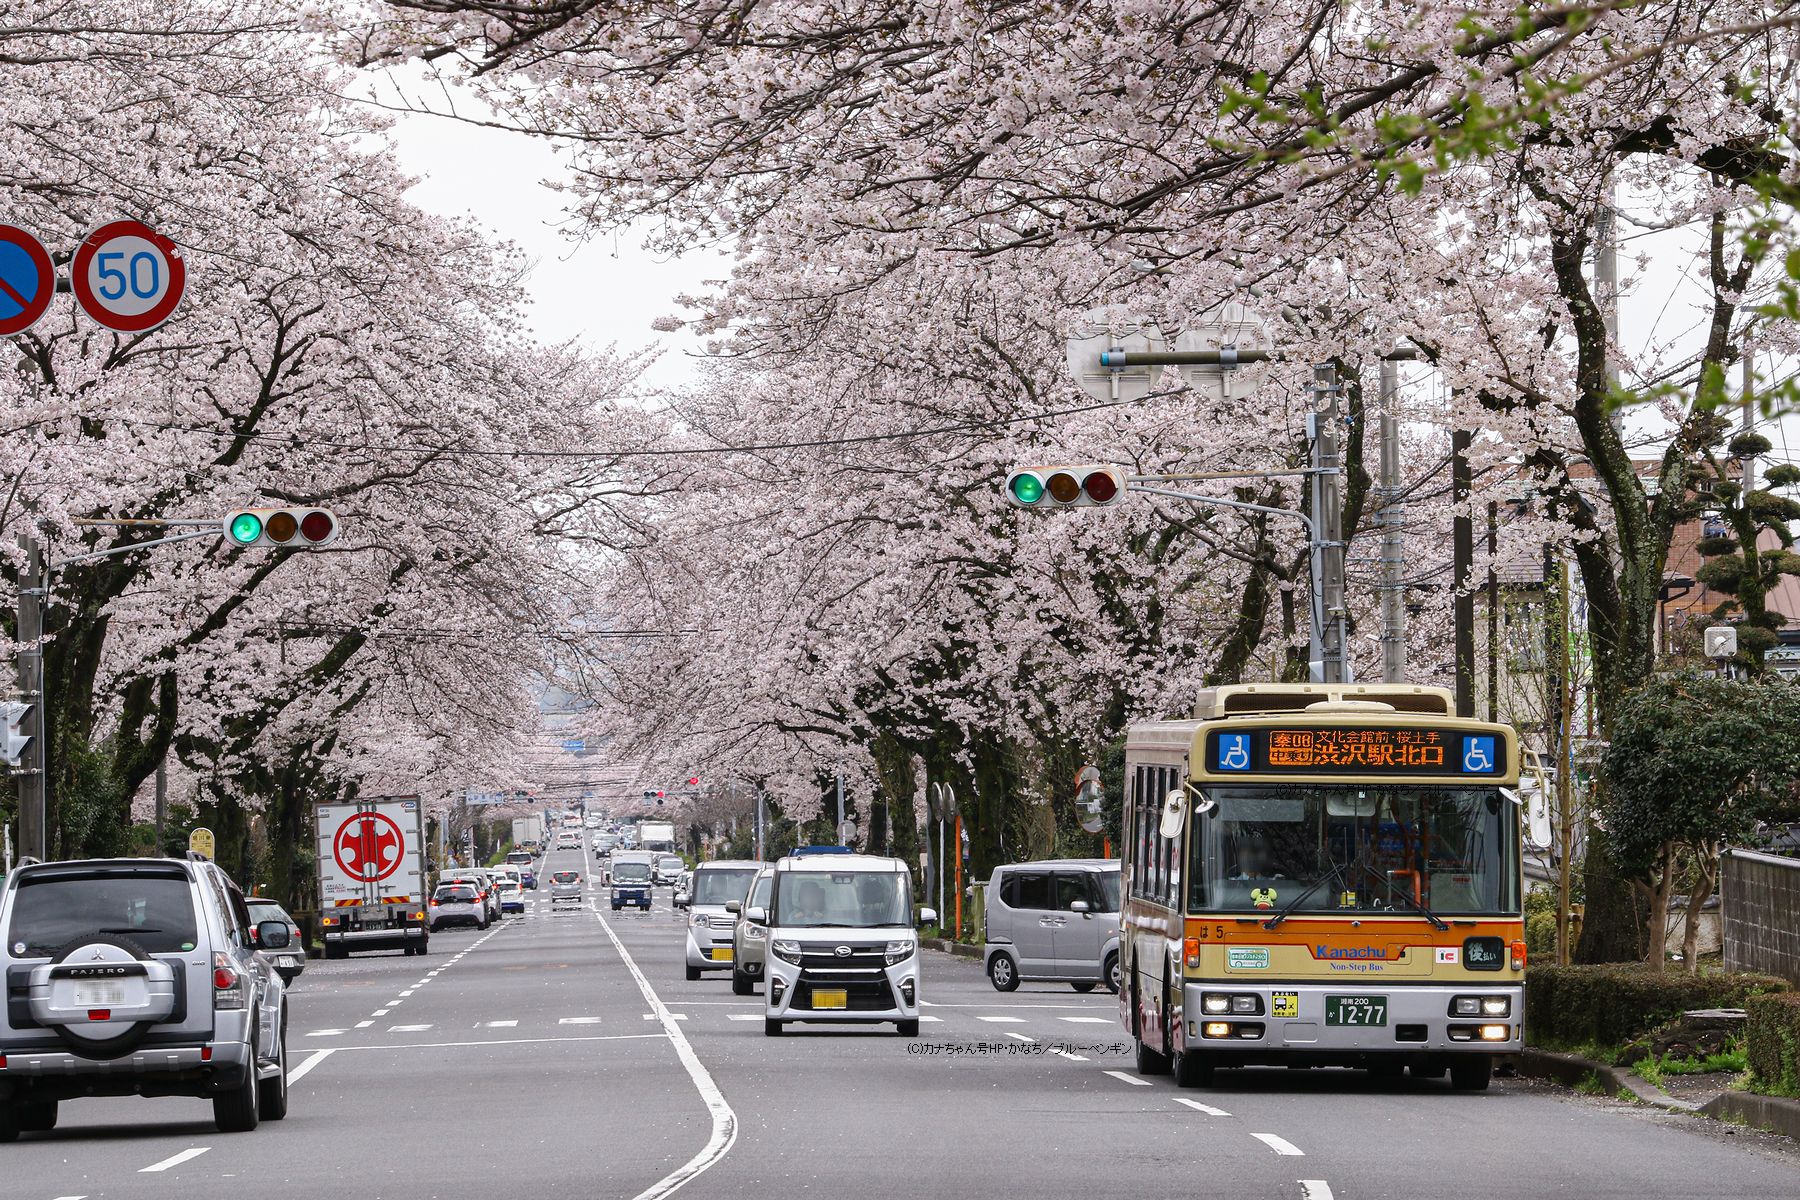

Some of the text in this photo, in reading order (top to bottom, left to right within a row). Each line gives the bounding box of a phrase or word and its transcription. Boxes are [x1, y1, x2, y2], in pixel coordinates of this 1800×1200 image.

[98, 251, 159, 300] 50
[1316, 731, 1440, 744] 文化会館前・桜土手
[1314, 743, 1443, 766] 渋沢駅北口
[1200, 925, 1224, 939] は 5
[1317, 944, 1386, 958] Kanachu
[1468, 943, 1497, 961] 後払い
[70, 967, 125, 975] PAJERO
[1330, 963, 1384, 972] Non-Step Bus
[1339, 1005, 1384, 1024] 12-77
